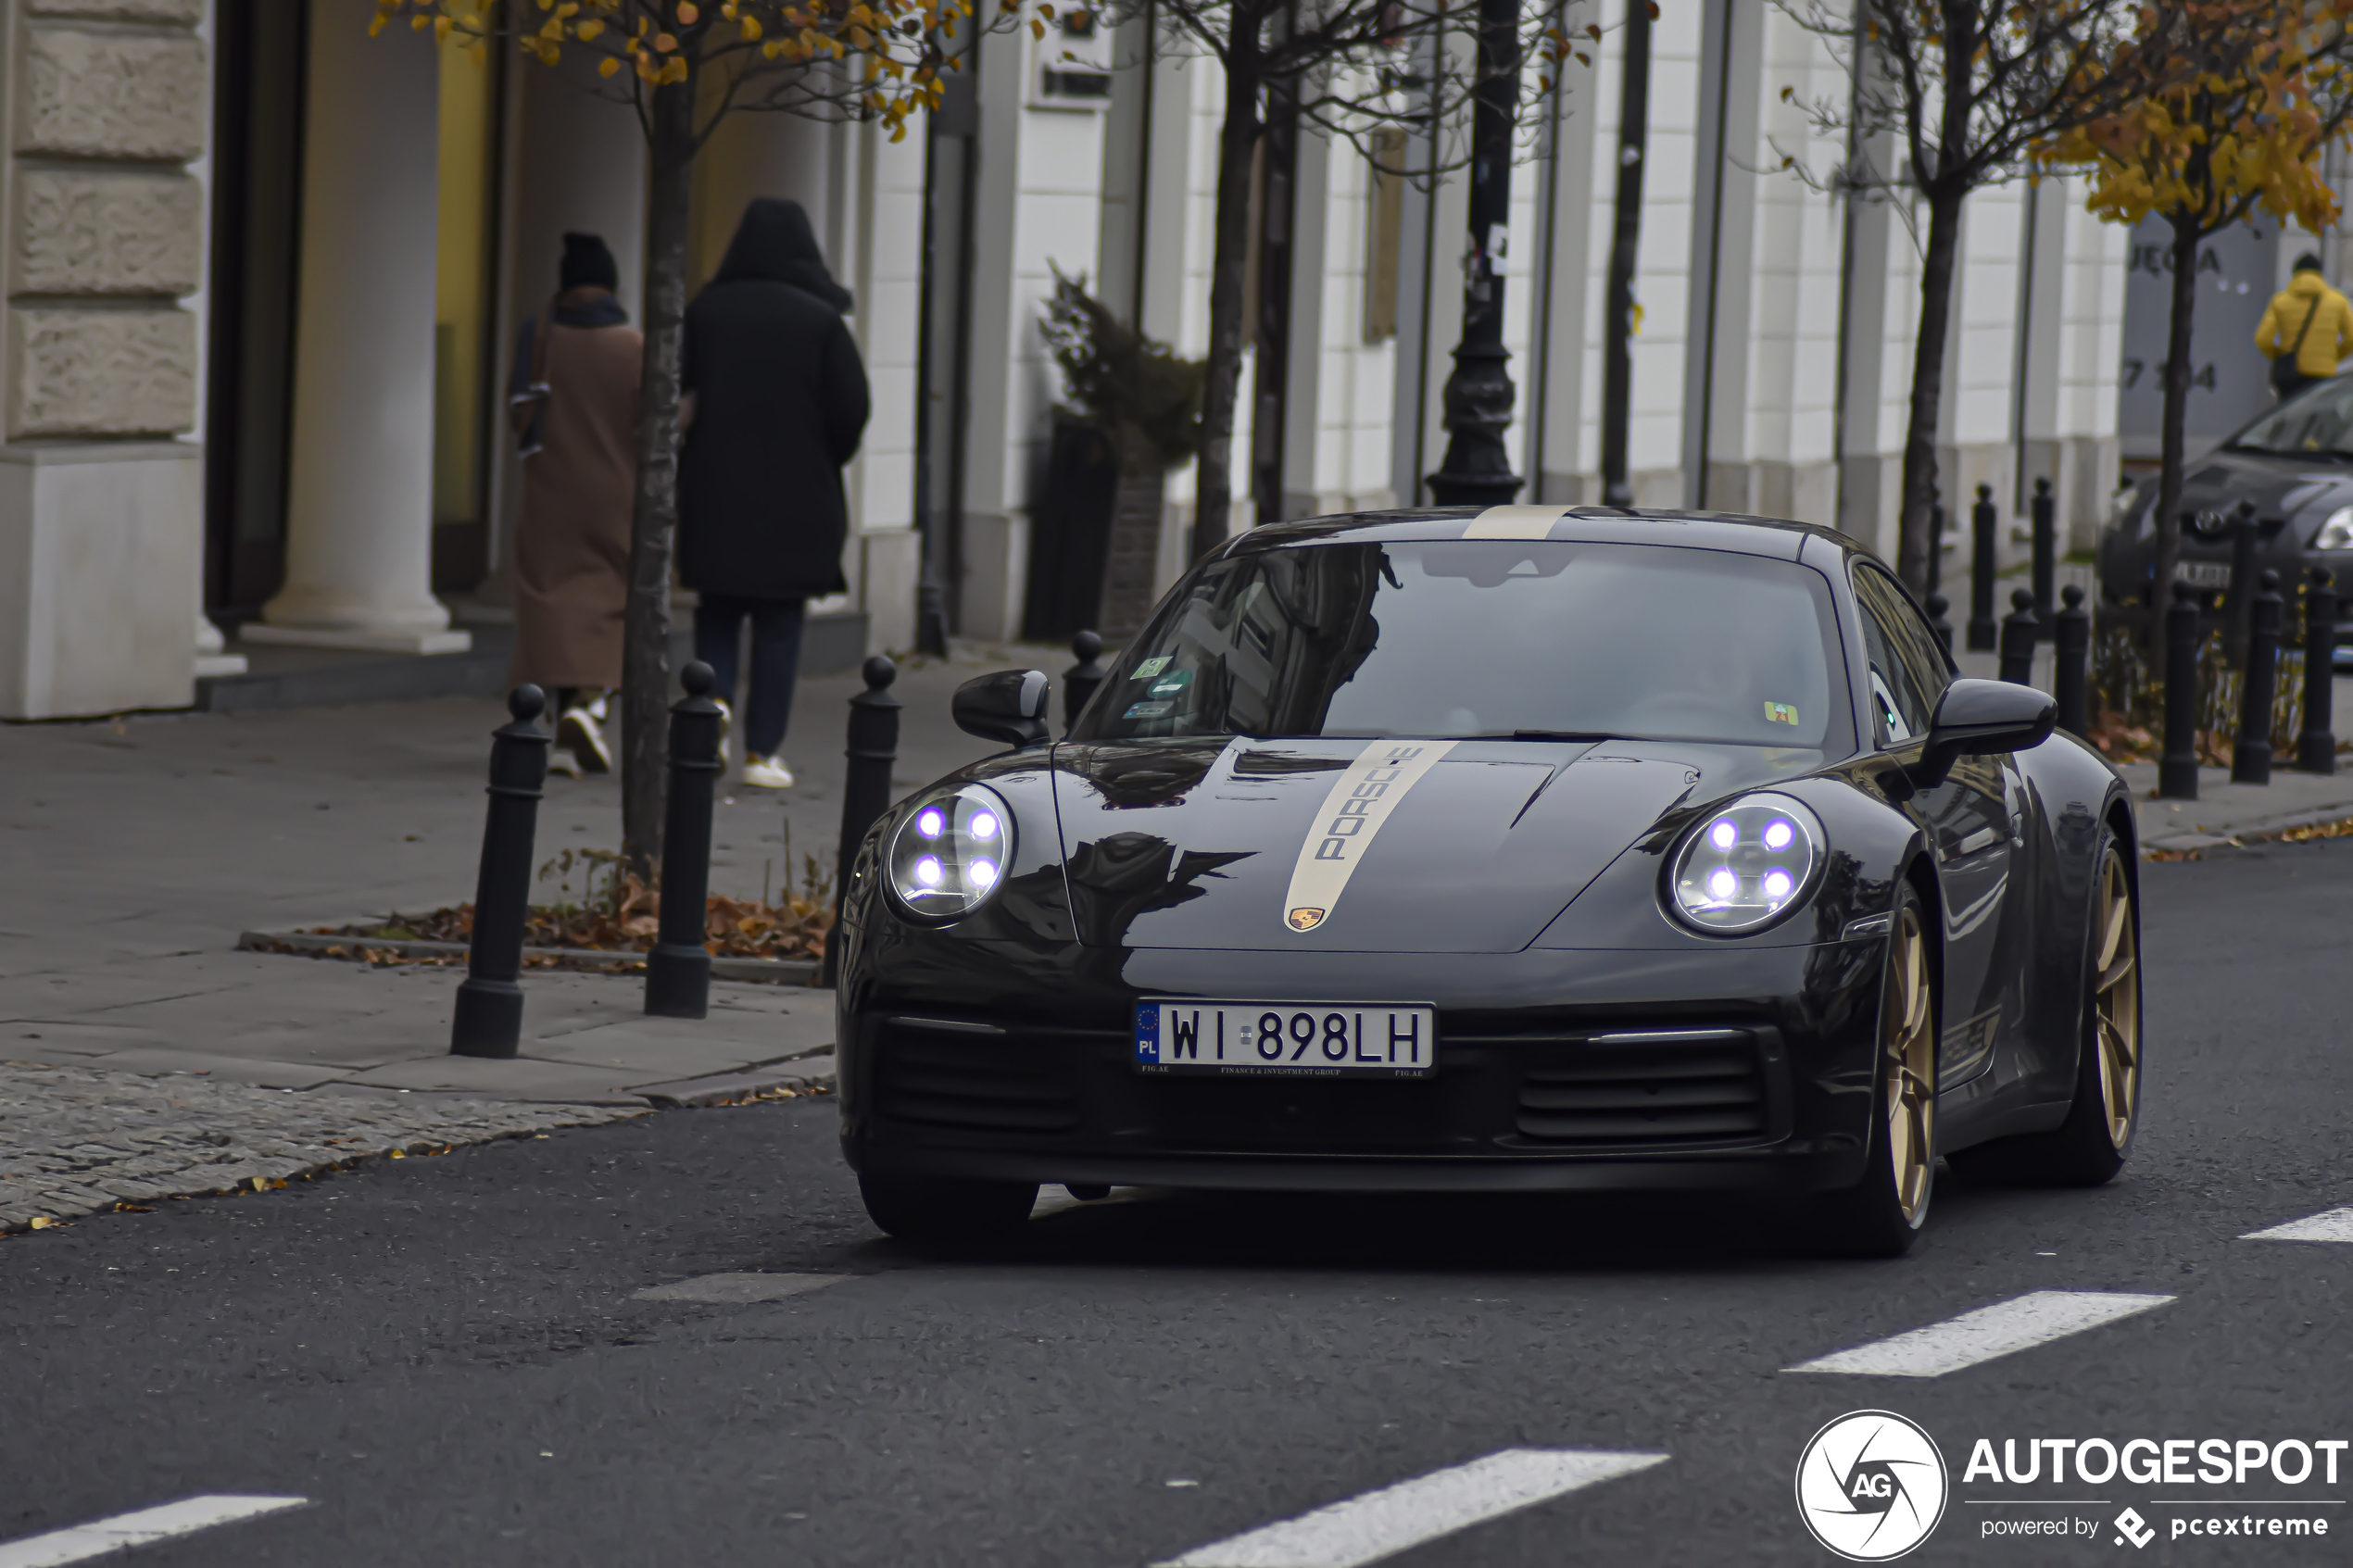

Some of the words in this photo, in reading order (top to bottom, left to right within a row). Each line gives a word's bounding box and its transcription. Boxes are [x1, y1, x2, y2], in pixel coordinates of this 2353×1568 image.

[1315, 747, 1424, 859] PORSCHE
[1139, 1040, 1156, 1054] PL
[1171, 1009, 1224, 1060] WI
[1257, 1011, 1419, 1062] 898LH
